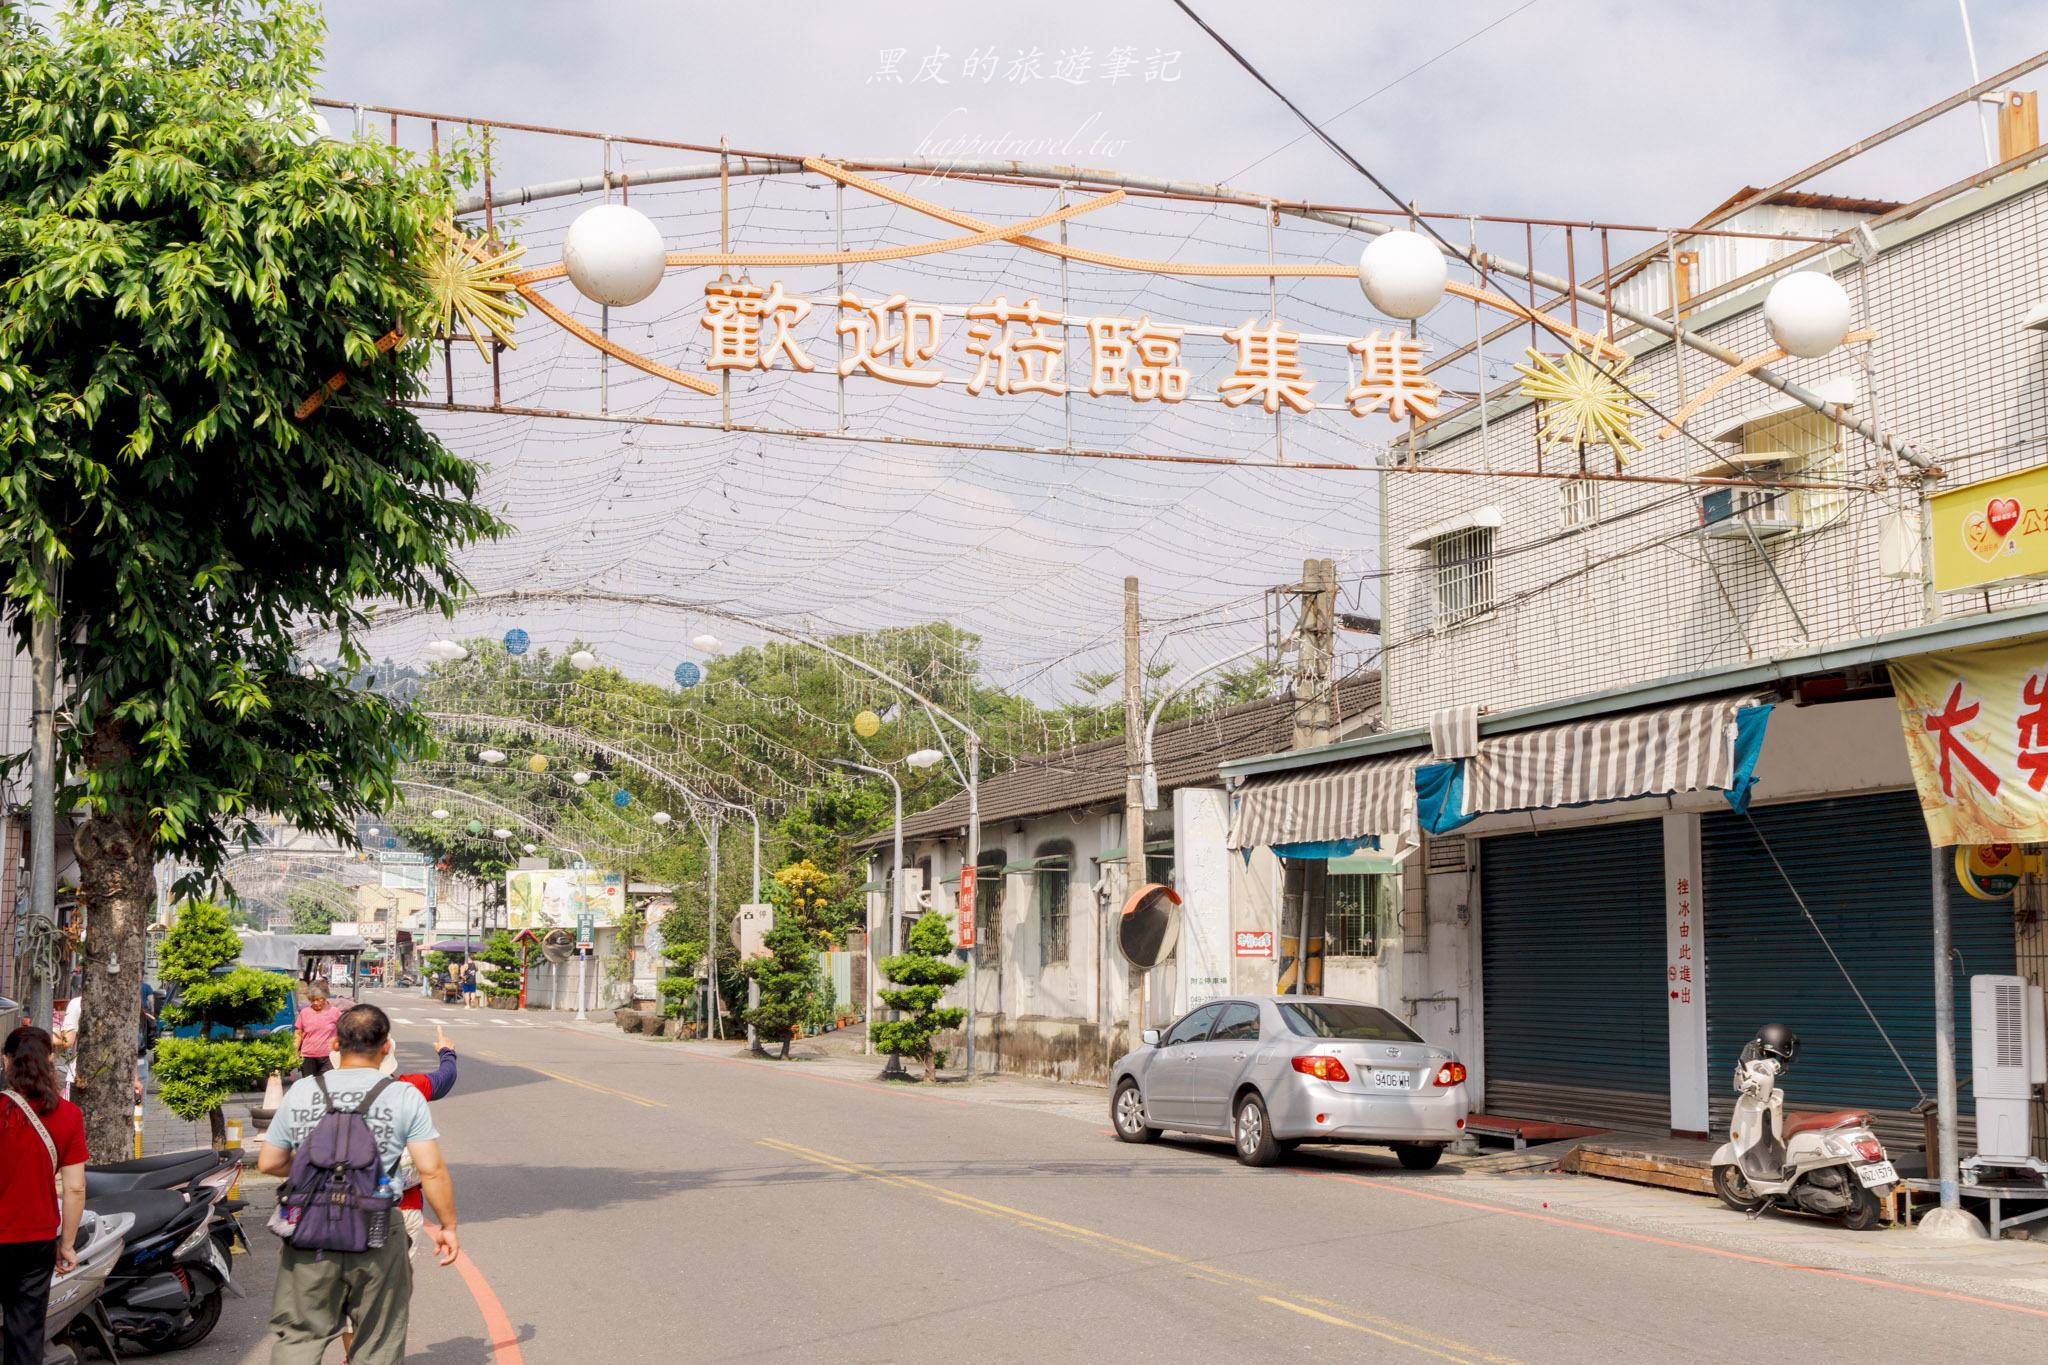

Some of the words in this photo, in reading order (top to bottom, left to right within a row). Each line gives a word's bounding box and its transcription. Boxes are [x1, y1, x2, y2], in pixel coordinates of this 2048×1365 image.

[701, 274, 1443, 422] 歡迎蒞臨集集
[2022, 508, 2048, 535] 公
[1677, 878, 1692, 1004] 挫冰由此進出
[312, 1091, 364, 1106] BFOR
